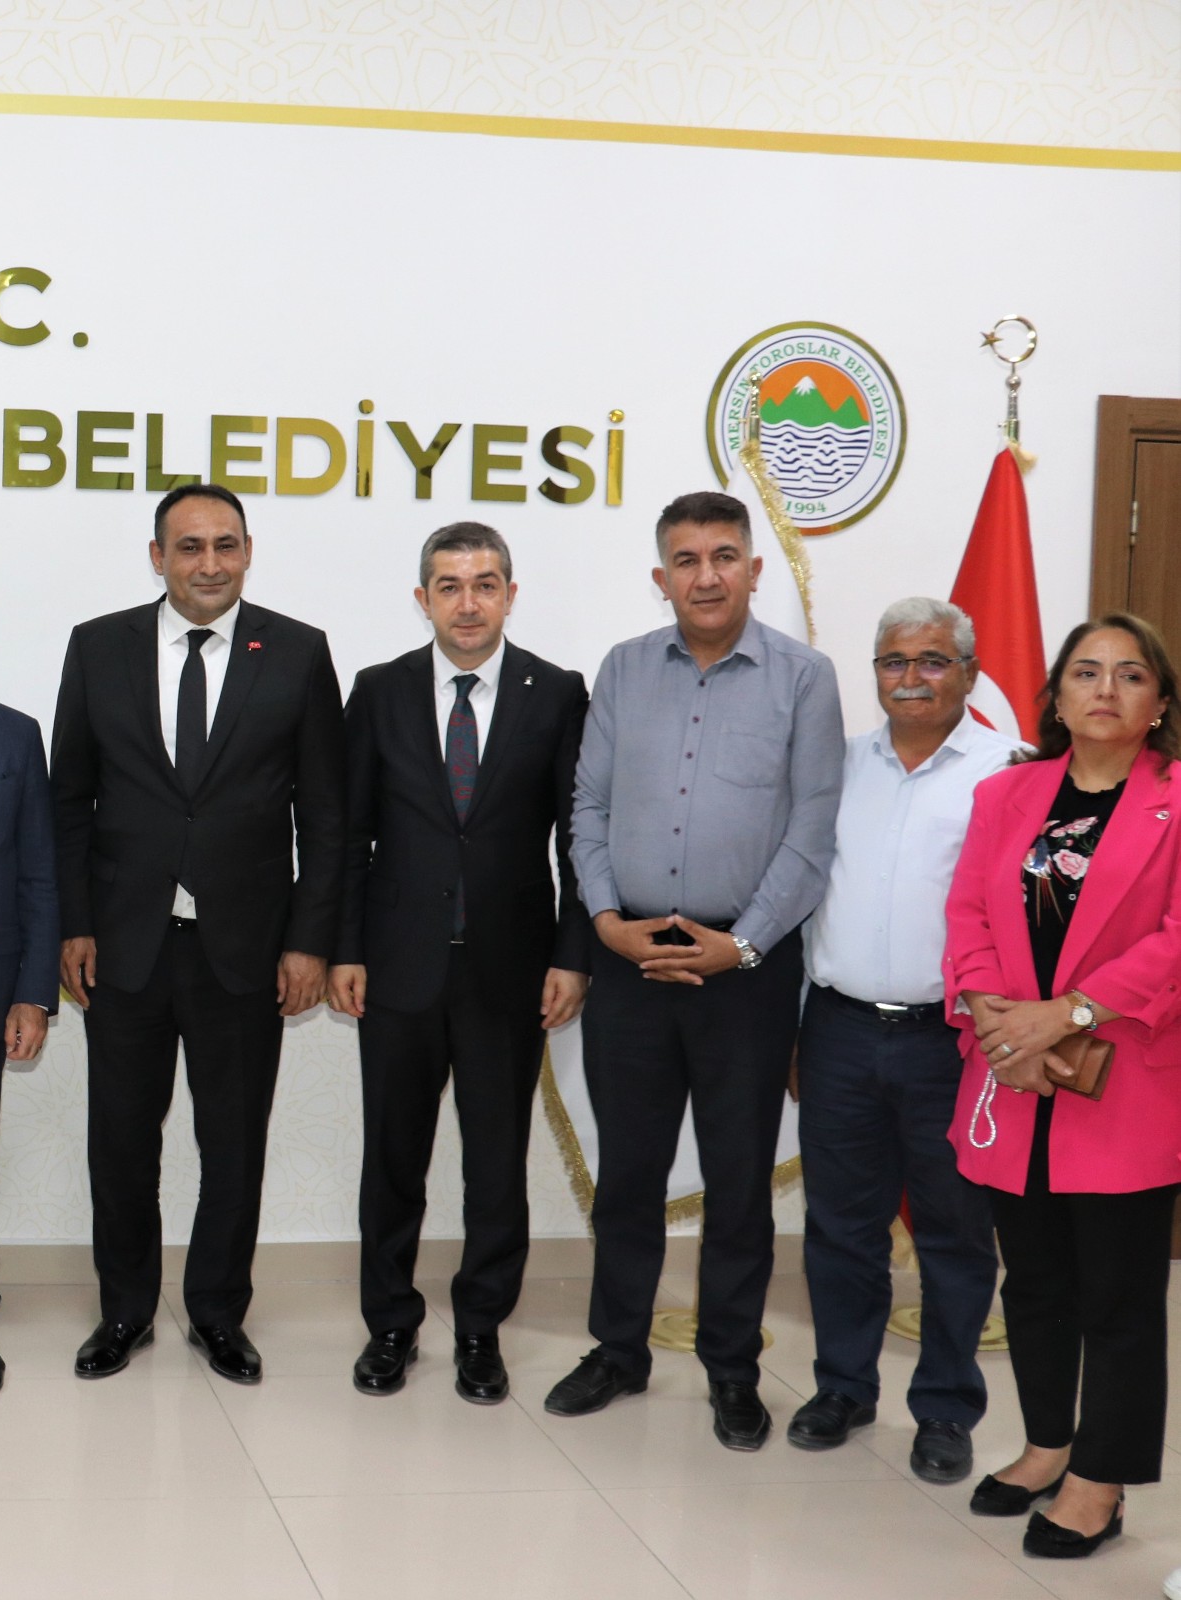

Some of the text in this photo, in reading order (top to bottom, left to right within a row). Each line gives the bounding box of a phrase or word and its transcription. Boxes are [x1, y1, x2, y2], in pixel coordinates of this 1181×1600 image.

[2, 398, 625, 506] BELEDİYESİ
[728, 376, 751, 450] MERSİN
[843, 355, 888, 460] BELEDİYESİ
[785, 500, 827, 514] 1994
